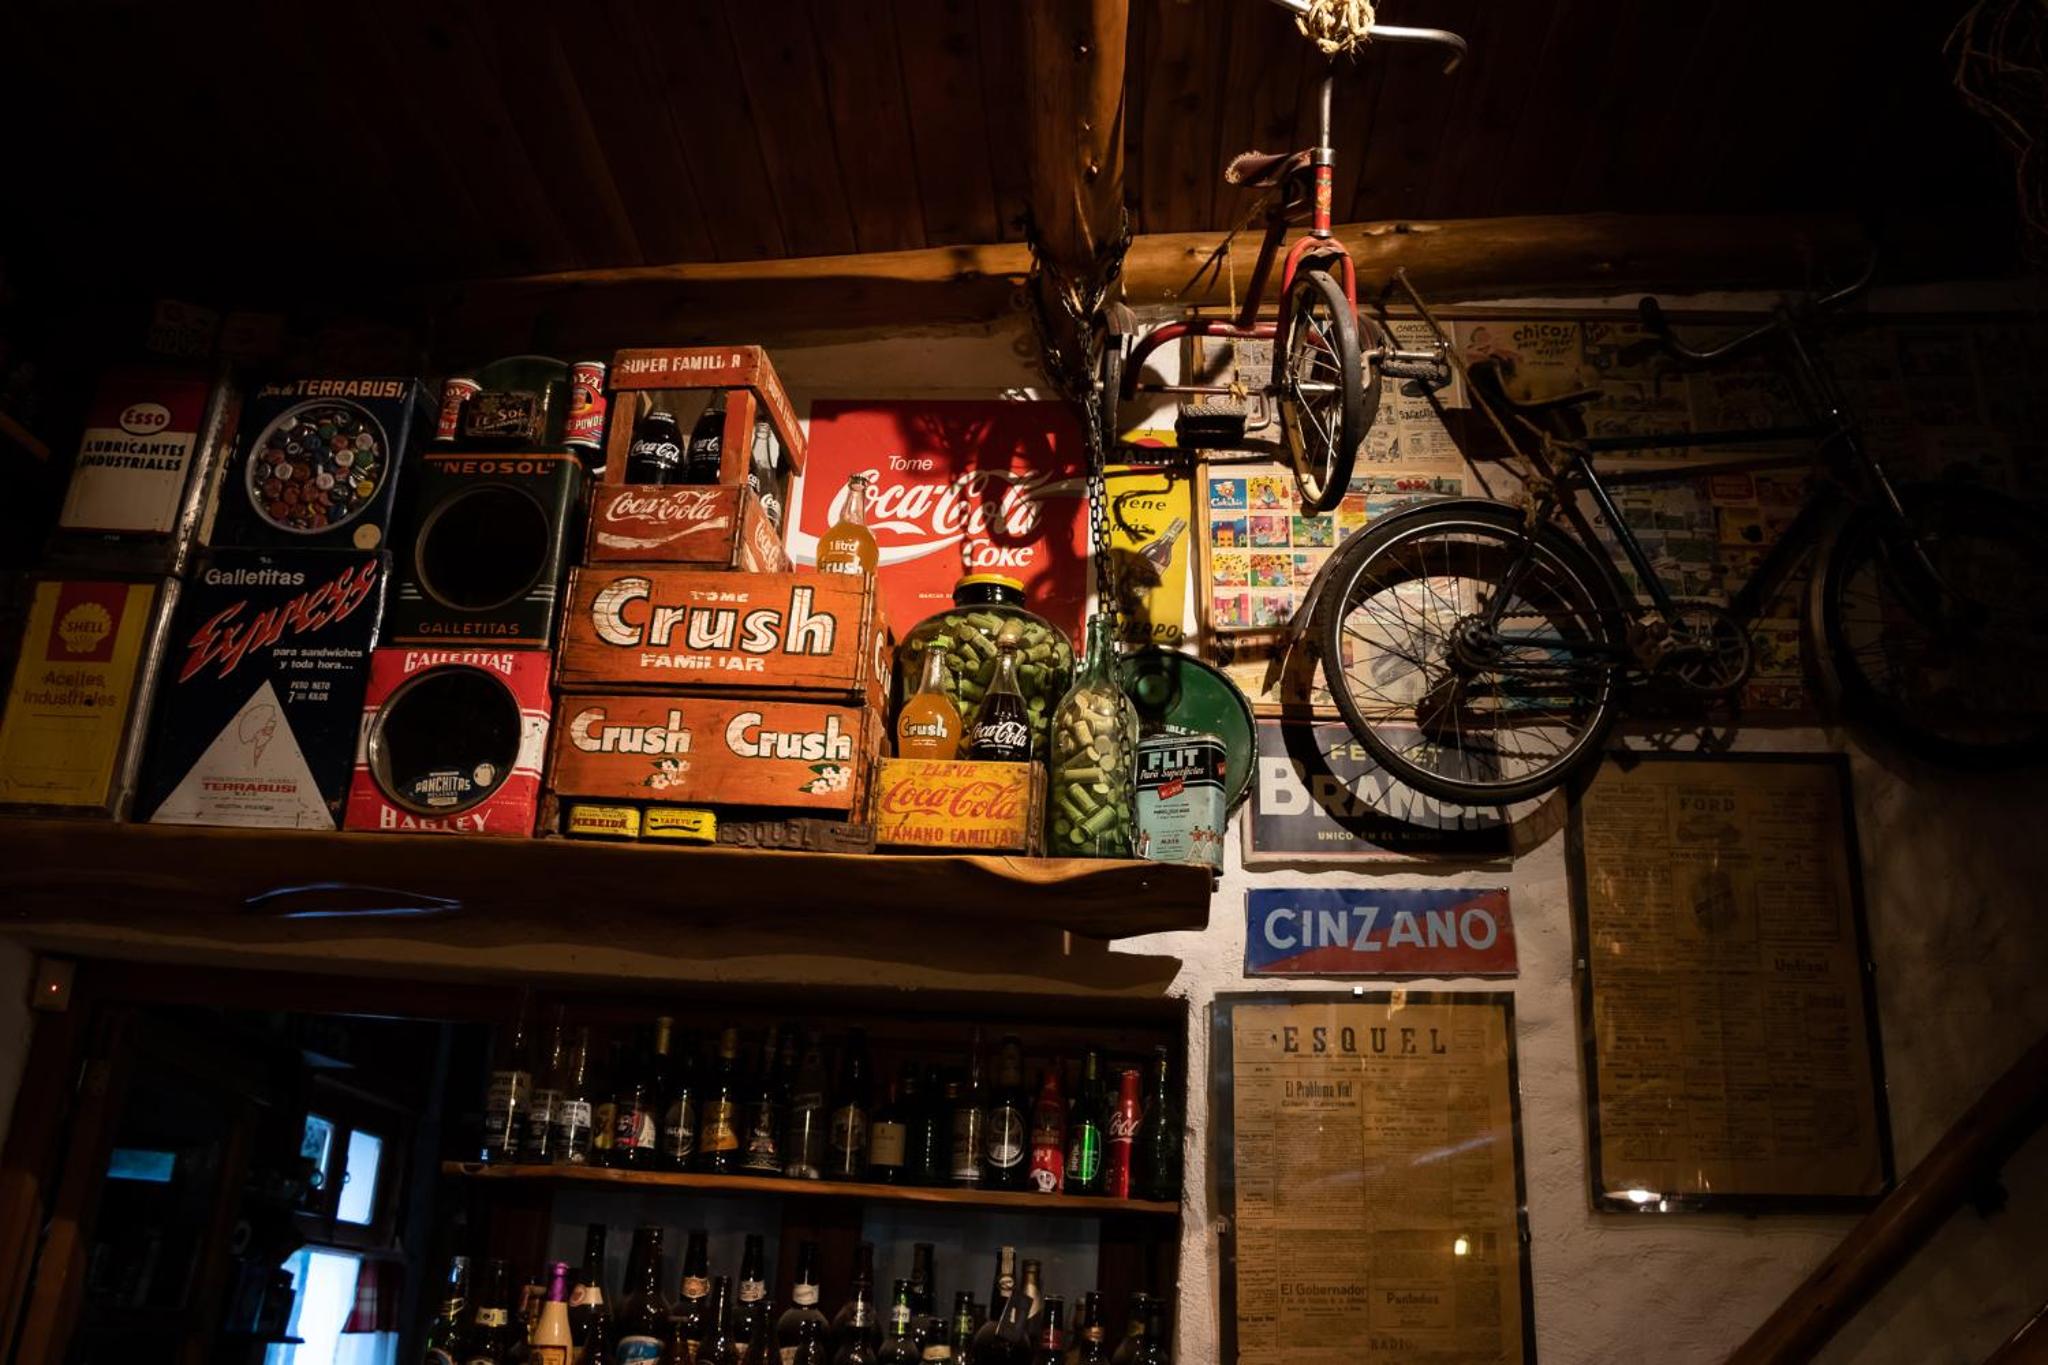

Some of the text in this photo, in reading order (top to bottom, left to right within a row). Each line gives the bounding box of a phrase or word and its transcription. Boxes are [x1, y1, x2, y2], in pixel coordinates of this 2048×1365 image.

[622, 354, 741, 373] SUPER FAMILIR
[85, 440, 186, 456] LUBRICANTES
[81, 455, 182, 471] INDUSTRIALES
[888, 455, 933, 471] Tome
[827, 469, 1043, 535] Coca-Cola
[606, 491, 721, 533] Coca-Cola
[205, 568, 304, 586] Galletitas
[591, 576, 836, 655] Crush
[65, 621, 104, 633] SHELL
[418, 622, 521, 635] GALLETITAS
[1120, 622, 1178, 638] UERPO
[404, 651, 514, 676] GALLETITAS
[42, 672, 105, 688] Aceites
[24, 690, 118, 706] Industriales
[570, 706, 692, 754] Crush
[901, 713, 947, 739] Crush
[725, 711, 852, 760] Crush
[1148, 749, 1199, 770] FLIT
[1330, 744, 1442, 765] FEET
[202, 782, 297, 793] TERRABUSI
[415, 776, 471, 793] PANCHITAS
[950, 828, 1022, 845] FAMILIAR
[1318, 832, 1353, 841] UNICO
[1264, 907, 1497, 951] CINZANO
[1283, 1026, 1447, 1055] ESQUEL
[1280, 1284, 1294, 1296] El
